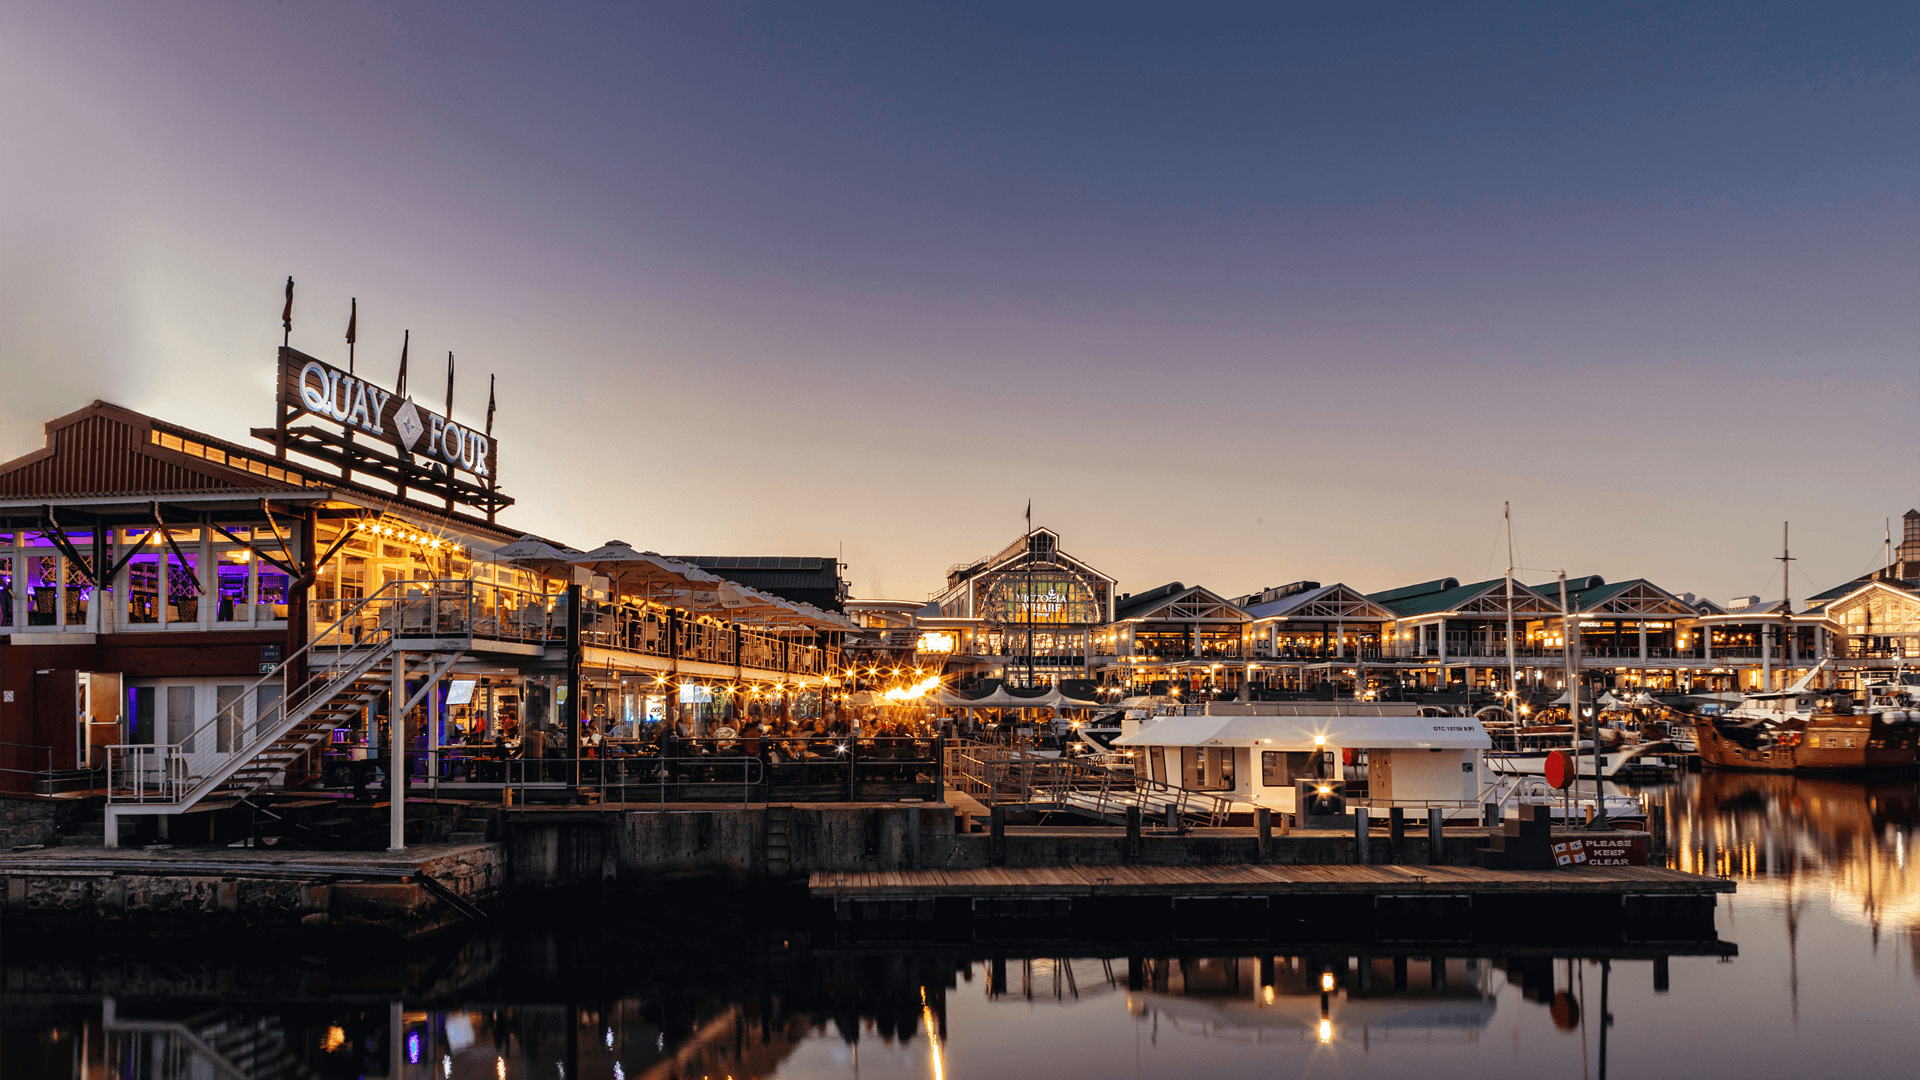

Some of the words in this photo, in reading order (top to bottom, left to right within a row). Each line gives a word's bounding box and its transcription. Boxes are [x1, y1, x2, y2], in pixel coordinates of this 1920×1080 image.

[299, 361, 390, 435] QUAY
[427, 411, 489, 476] FOUR
[1016, 594, 1067, 603] VICTOIA
[1022, 603, 1061, 612] WHARF
[1588, 858, 1630, 866] CLEAR
